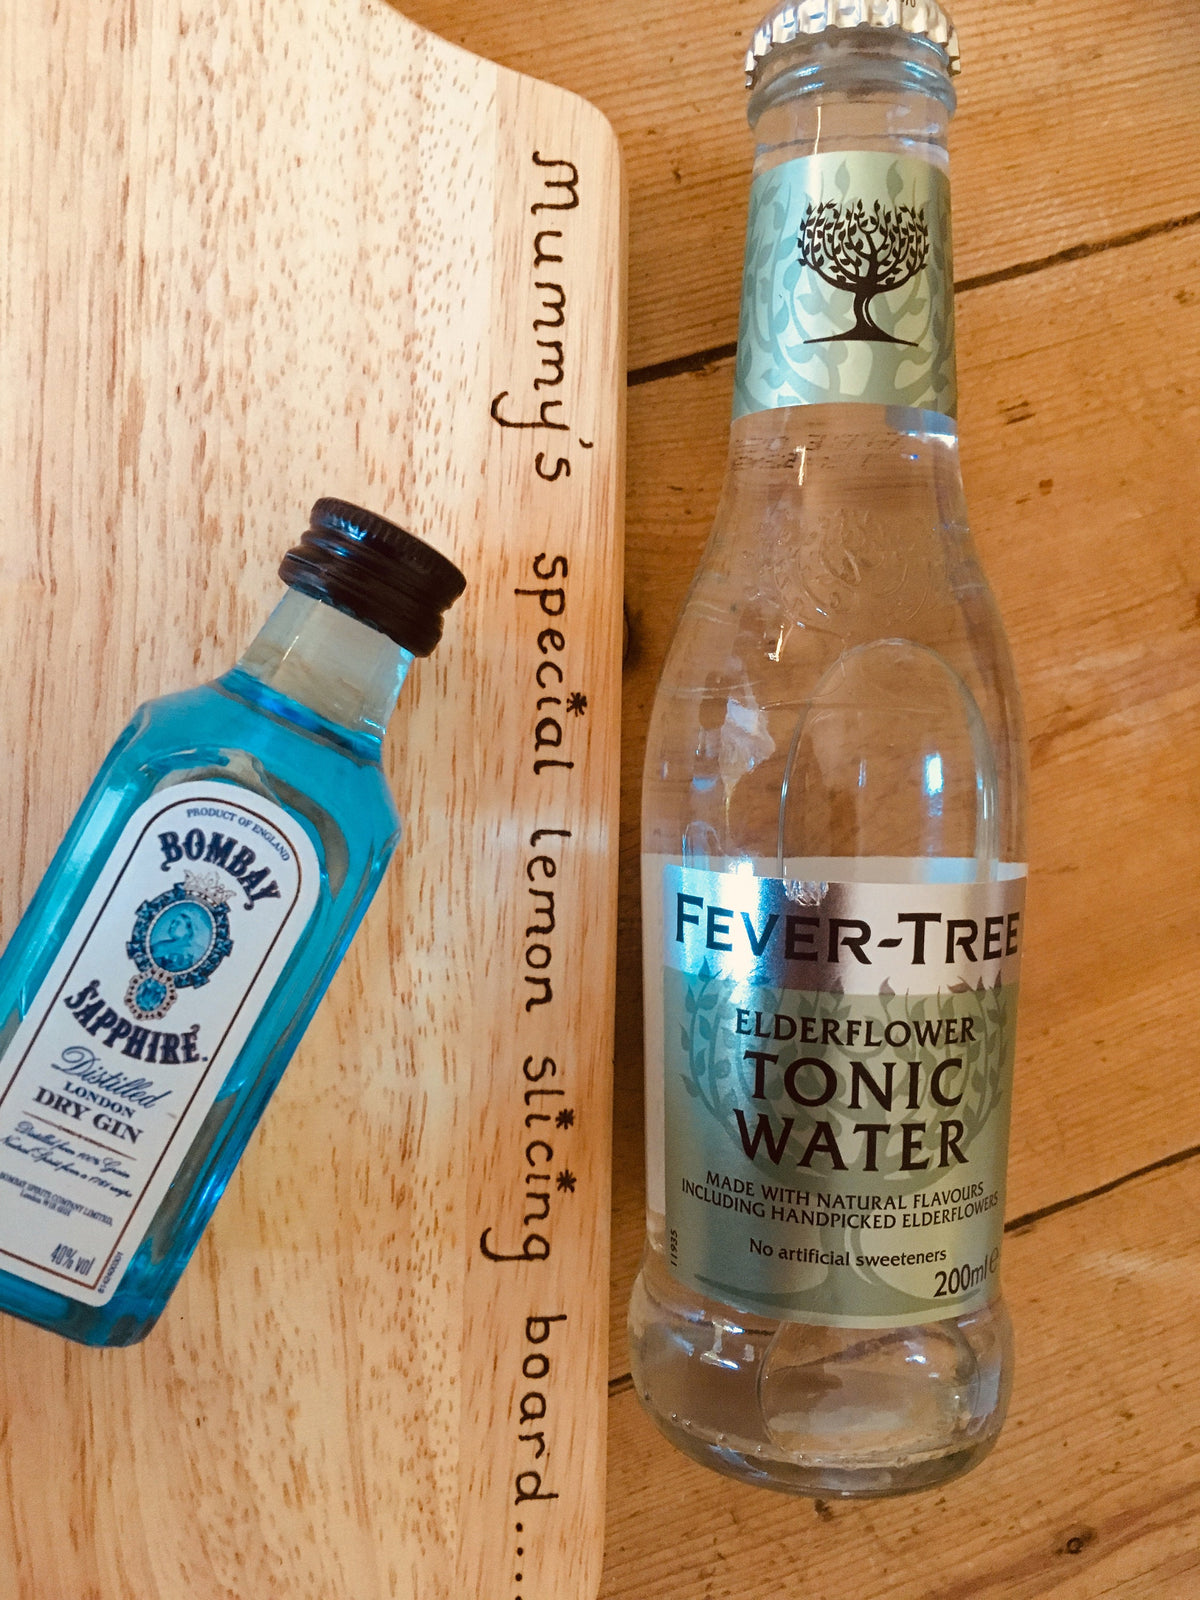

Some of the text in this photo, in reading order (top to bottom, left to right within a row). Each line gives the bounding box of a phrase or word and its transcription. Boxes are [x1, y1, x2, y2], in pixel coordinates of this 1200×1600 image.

[514, 552, 588, 775] special
[186, 807, 290, 861] PRODUCT OF ENGLAND
[157, 828, 282, 911] BOMBAY
[525, 828, 572, 1012] lemon
[675, 892, 1021, 965] FEVER-TREE
[735, 1008, 977, 1047] ELDERFLOWER
[51, 1045, 173, 1109] Distilled
[63, 1081, 136, 1119] LONDON
[743, 1050, 963, 1112] TONIC
[32, 1086, 144, 1145] DRY GIN
[733, 1109, 969, 1172] WATER
[479, 1055, 577, 1262] slicing
[681, 1177, 999, 1230] INCLUDING HANDPICKED ELDERFLOWERS
[705, 1170, 984, 1211] MADE WITH NATURAL FLAVOURS
[50, 1243, 96, 1276] 40% vol
[669, 1228, 678, 1267] 11935
[750, 1237, 947, 1267] No artificial sweeteners
[933, 1254, 988, 1298] 200ml
